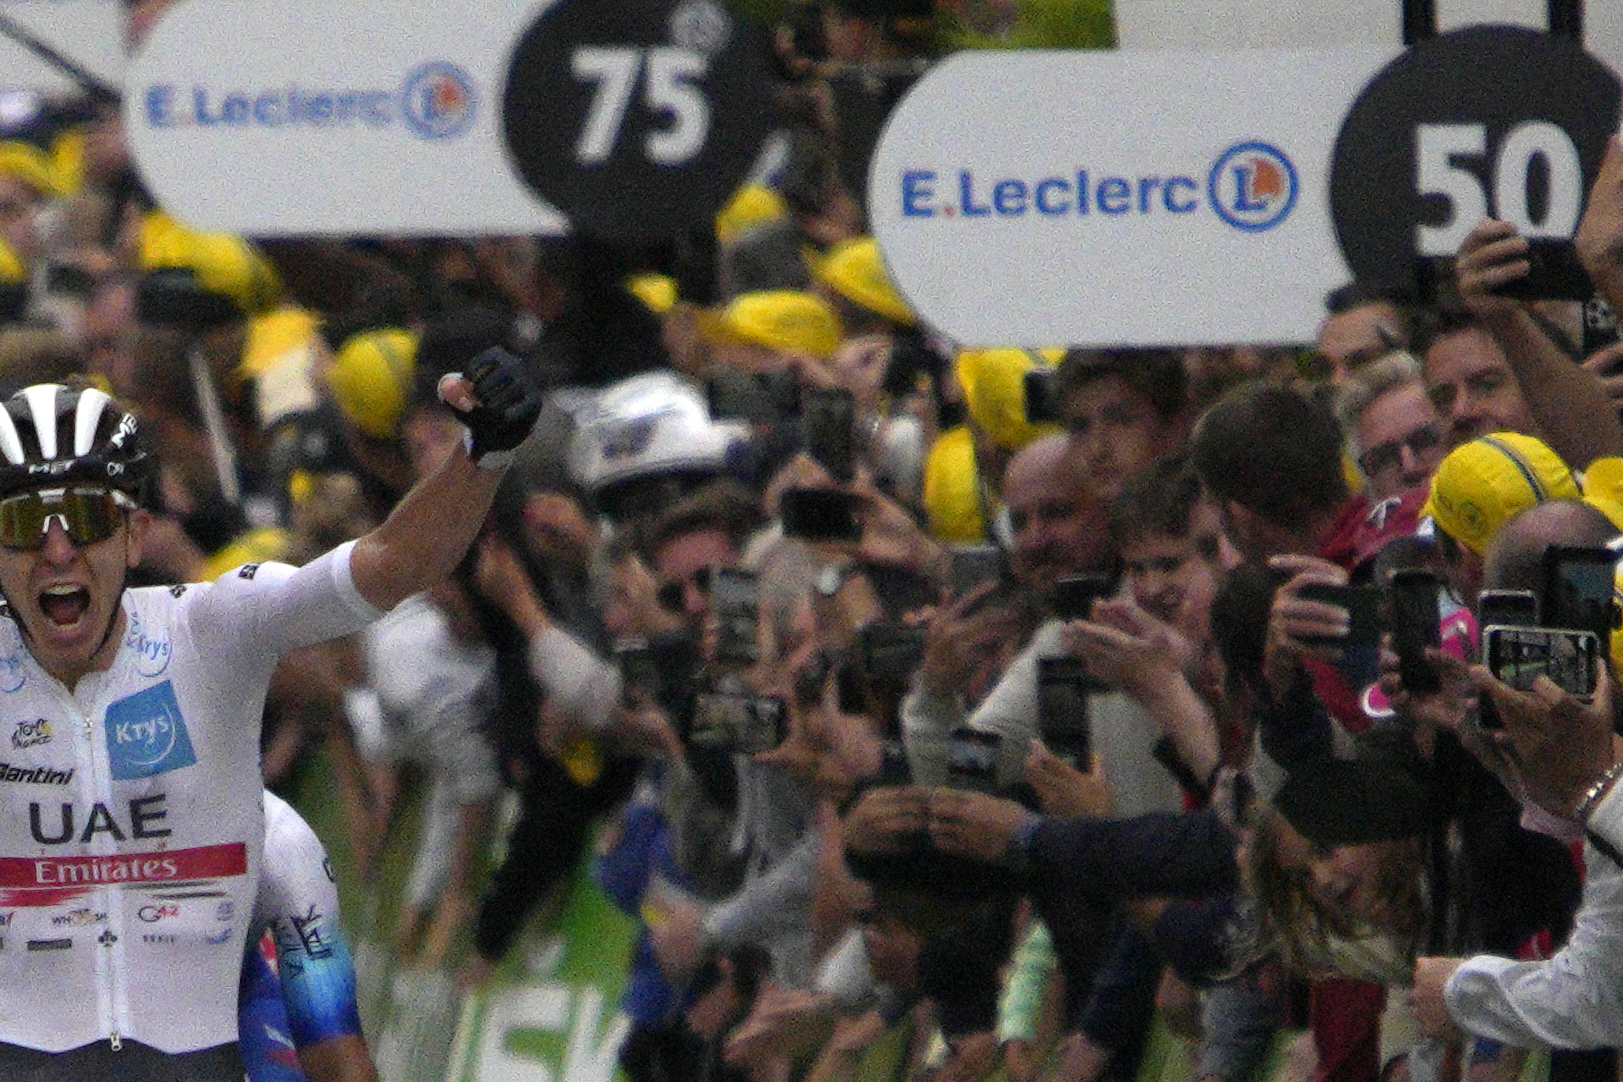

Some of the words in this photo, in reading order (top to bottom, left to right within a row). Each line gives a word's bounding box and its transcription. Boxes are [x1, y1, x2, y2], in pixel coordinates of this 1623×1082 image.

[145, 82, 391, 128] E.Leclerc
[572, 45, 711, 167] 75
[900, 168, 1198, 218] E.Leclerc
[1416, 119, 1584, 258] 50
[29, 793, 172, 845] UAE
[34, 859, 178, 884] Emirates
